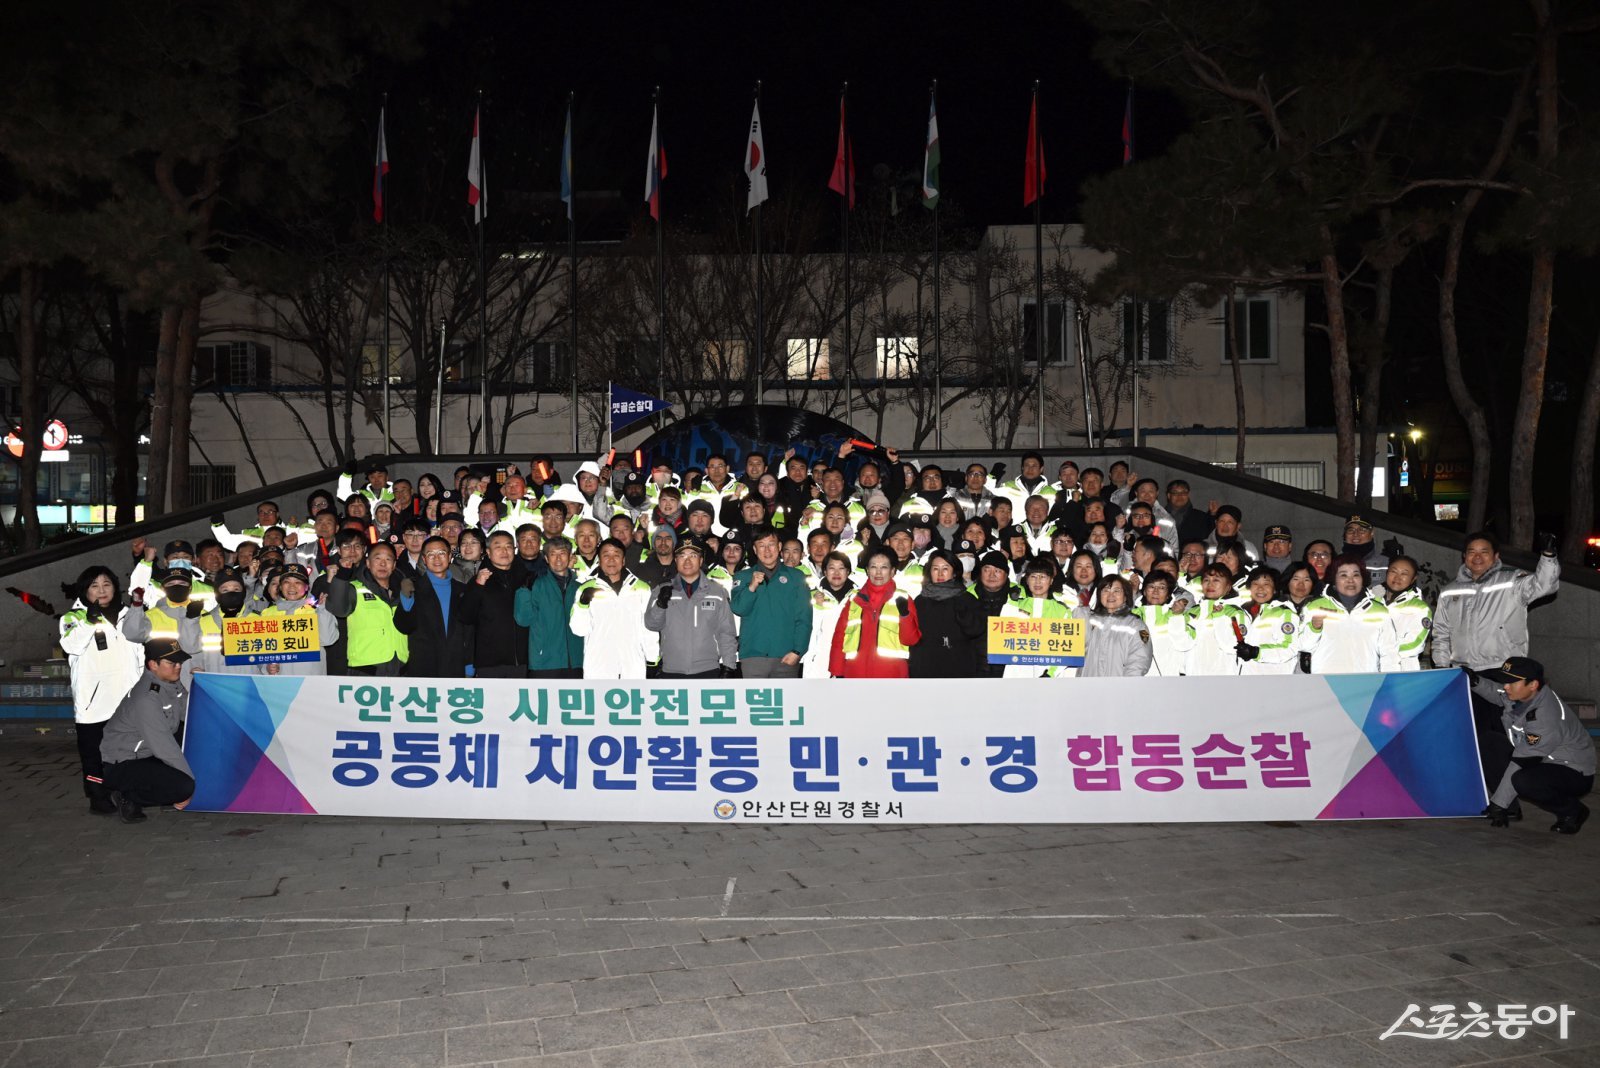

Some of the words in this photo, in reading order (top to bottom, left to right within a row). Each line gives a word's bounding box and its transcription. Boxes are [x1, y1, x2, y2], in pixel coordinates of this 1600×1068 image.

[226, 620, 279, 634] 确立基础
[282, 618, 314, 632] 秩序!
[992, 621, 1043, 635] 기초질서
[1049, 622, 1080, 635] 확립!
[236, 638, 278, 652] 洁净的
[283, 636, 309, 650] 安山
[1003, 637, 1040, 651] 깨끗한
[1047, 639, 1073, 652] 안산
[338, 685, 484, 724] 「안산형
[509, 687, 804, 726] 시민안전모델」
[331, 730, 500, 789] 공동체
[525, 734, 759, 793] 치안활동
[1067, 731, 1312, 792] 합동순찰
[743, 800, 903, 819] 안산단원경찰서
